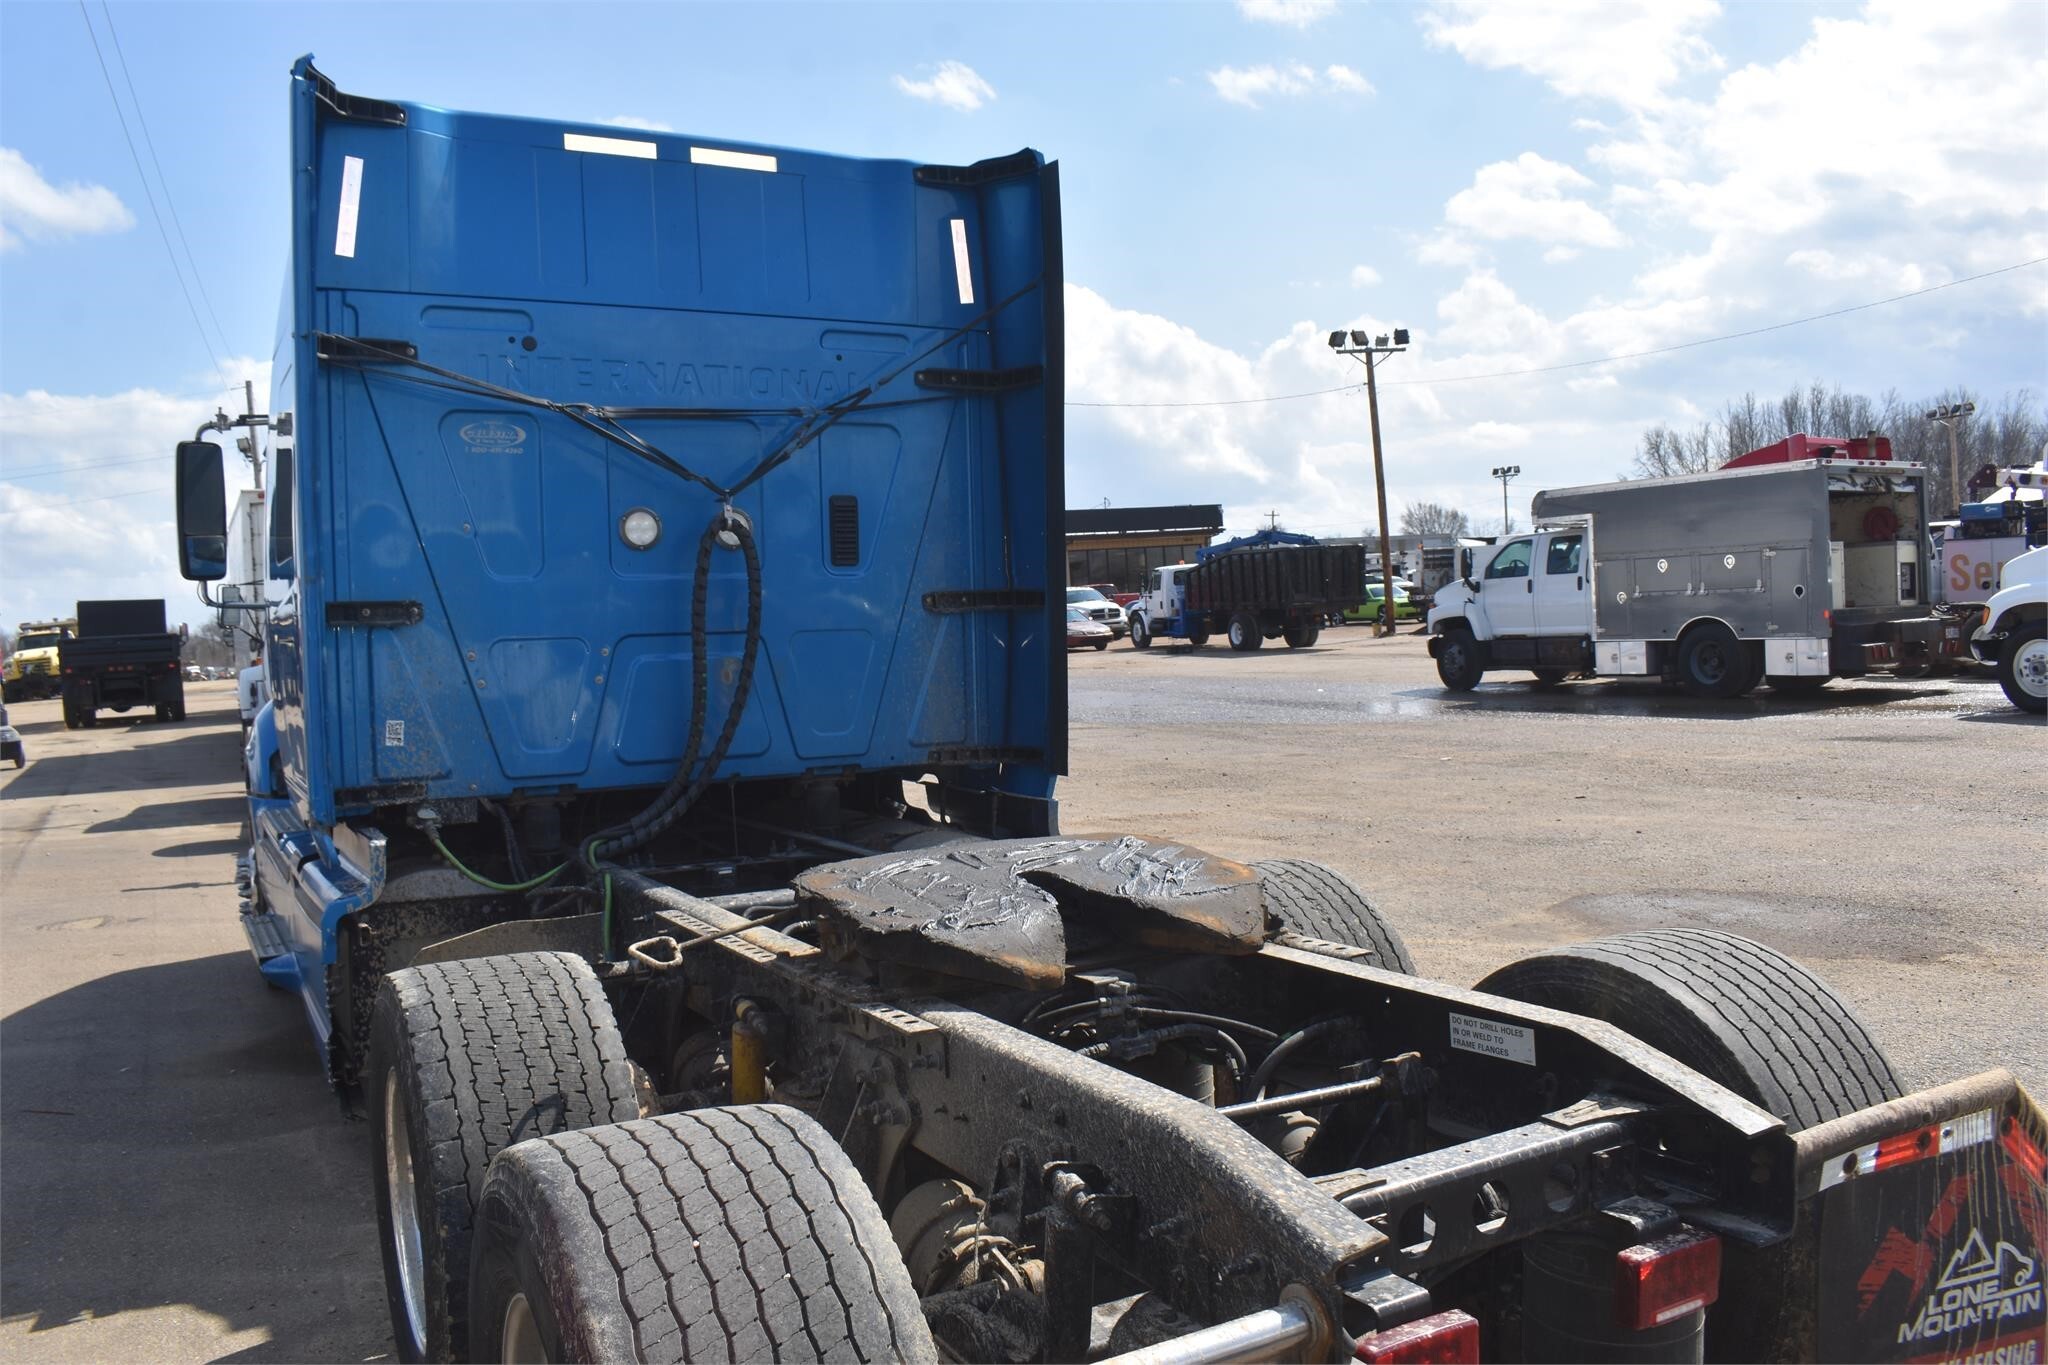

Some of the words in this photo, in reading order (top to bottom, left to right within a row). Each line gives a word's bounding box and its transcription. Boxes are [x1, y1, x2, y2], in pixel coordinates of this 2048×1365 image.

[477, 353, 869, 403] INTERNATIONAL
[1451, 1016, 1462, 1024] DO
[1463, 1019, 1478, 1027] NOT
[1479, 1022, 1498, 1033] DRILL
[1500, 1027, 1524, 1038] HOLES
[1452, 1027, 1460, 1035] IN
[1461, 1029, 1471, 1038] OR
[1472, 1031, 1492, 1042] WELD
[1494, 1036, 1504, 1045] TO
[1453, 1037, 1476, 1049] FRAME
[1477, 1044, 1509, 1057] FLANGES
[1927, 1279, 2000, 1315] LONE
[1897, 1290, 2041, 1344] MOUNTAIN
